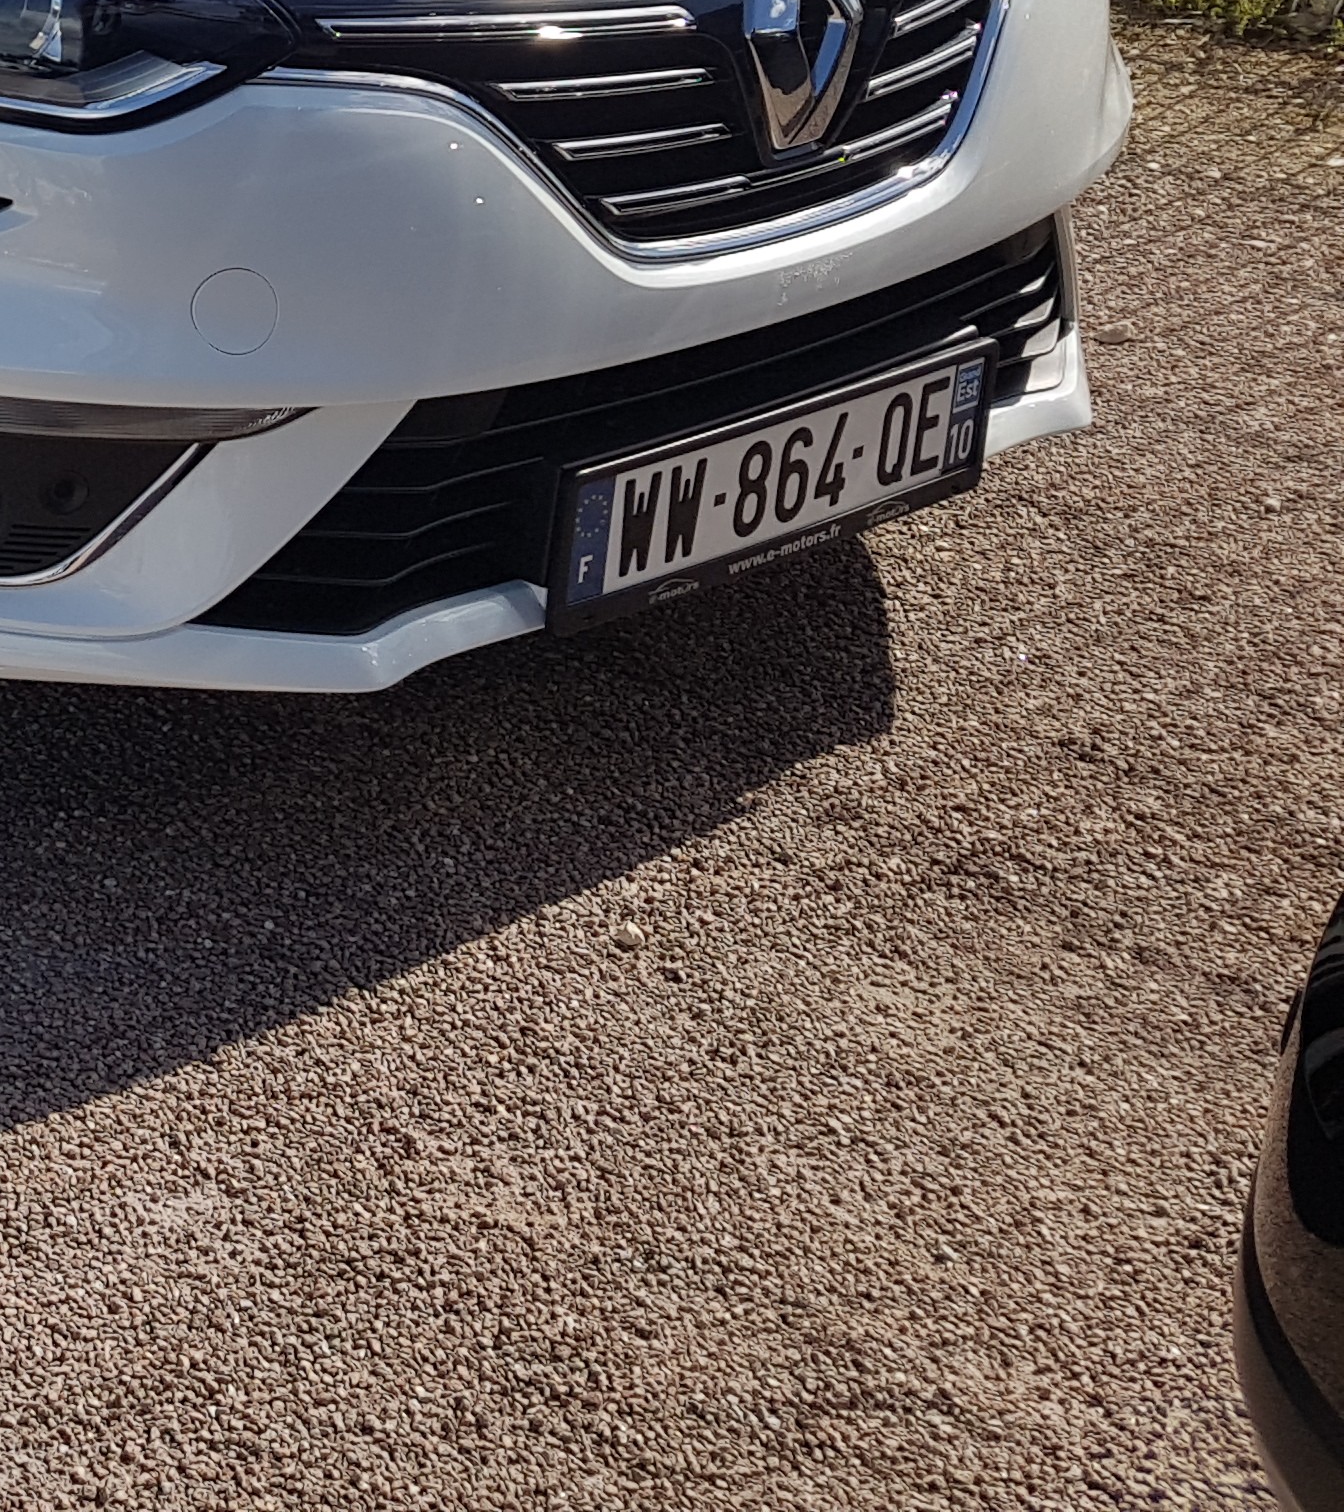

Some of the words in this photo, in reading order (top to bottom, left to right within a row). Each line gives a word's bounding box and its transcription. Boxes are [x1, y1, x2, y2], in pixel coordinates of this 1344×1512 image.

[956, 378, 980, 402] Est
[948, 418, 974, 465] 10
[618, 376, 952, 578] WW-864-QE
[577, 554, 594, 584] F
[728, 523, 842, 575] www.e-motors.fr
